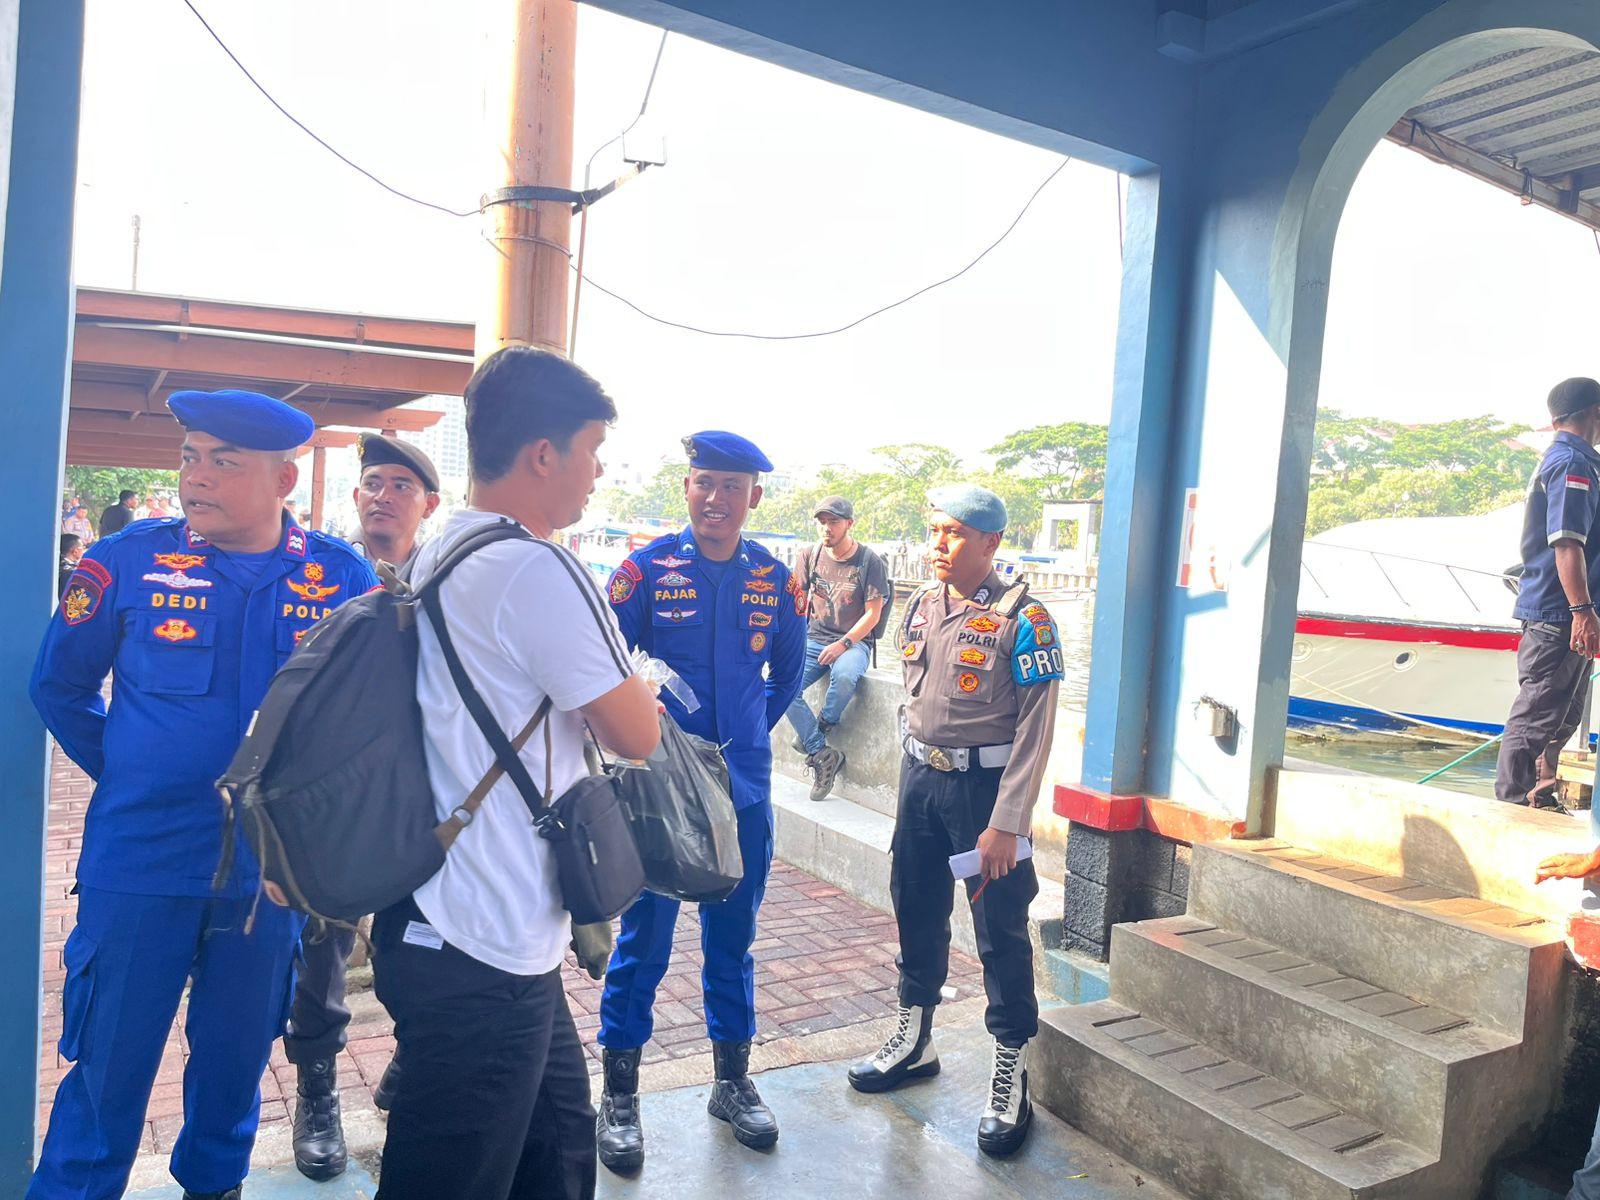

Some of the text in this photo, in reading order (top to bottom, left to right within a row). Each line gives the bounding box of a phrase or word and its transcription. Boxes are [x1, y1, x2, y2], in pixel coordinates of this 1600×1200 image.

[152, 593, 207, 610] DEDI
[654, 588, 698, 601] FAJAR
[741, 593, 779, 607] POLRI
[957, 632, 997, 647] POLRI
